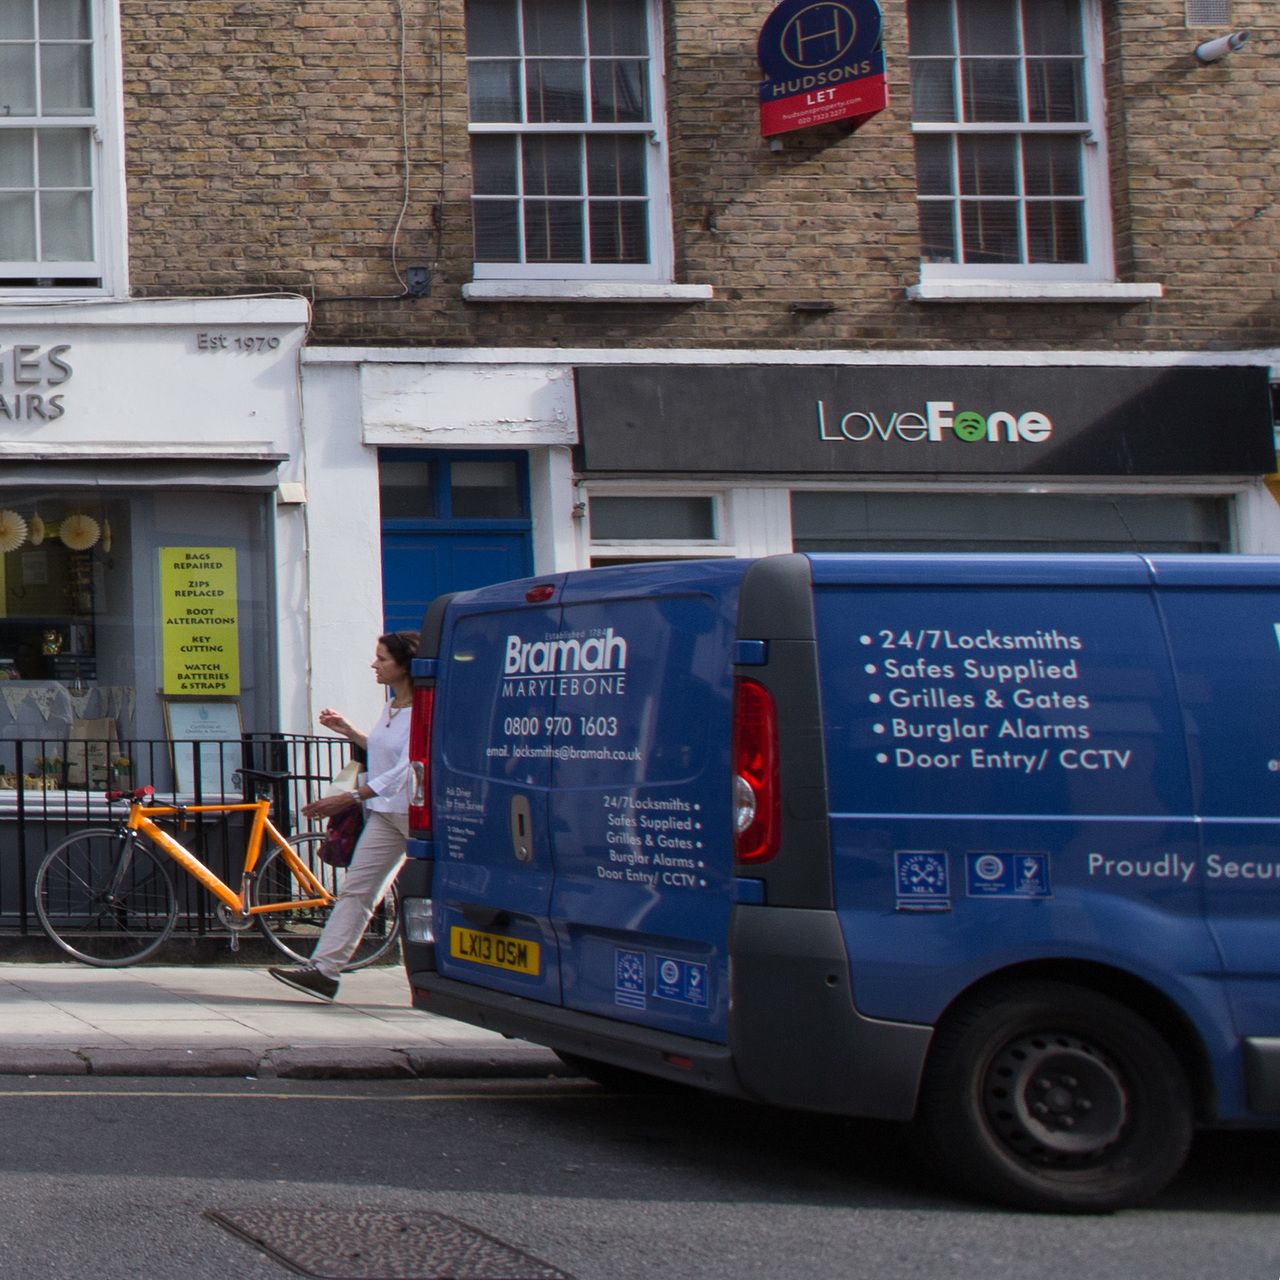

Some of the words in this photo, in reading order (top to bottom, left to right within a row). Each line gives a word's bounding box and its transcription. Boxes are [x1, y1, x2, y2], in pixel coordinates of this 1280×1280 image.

[772, 60, 871, 96] HUDSONS
[806, 88, 837, 106] LET
[196, 333, 228, 350] Est
[233, 336, 281, 352] 1970
[817, 399, 1053, 443] LoveFone
[173, 562, 223, 570] REPAIRED
[185, 553, 210, 561] BAGS
[188, 580, 210, 588] ZIPS
[175, 590, 224, 598] REPLACED
[166, 617, 235, 625] ALTERATIONS
[186, 608, 215, 616] BOOT
[545, 631, 585, 641] Established
[504, 627, 627, 674] Bramah
[184, 663, 220, 671] WATCH
[884, 658, 955, 679] Safes
[963, 658, 1078, 683] Supplied
[181, 682, 188, 690] &
[189, 682, 226, 690] STRAPS
[502, 677, 626, 697] MARYLEBONE
[889, 688, 976, 708] Grilles
[985, 689, 1004, 708] &
[1013, 689, 1090, 709] Gates
[504, 717, 539, 735] 0800
[545, 717, 572, 736] 970
[580, 716, 619, 736] 1603
[892, 718, 988, 742] Burglar
[998, 718, 1090, 739] Alarms
[513, 745, 642, 761] locksmiths@bramah.co.uk
[895, 748, 961, 768] Door
[970, 748, 1048, 773] Entry/
[1059, 749, 1132, 769] CCTV
[608, 813, 637, 827] Safes
[640, 815, 692, 831] Supplied
[606, 831, 641, 846] Grilles
[645, 834, 654, 847] &
[657, 835, 693, 849] Gates
[609, 849, 650, 866] Burglar
[653, 853, 695, 869] Alarms
[1088, 853, 1195, 883] Proudly
[597, 866, 623, 879] Door
[662, 872, 696, 887] CCTV
[460, 931, 491, 960] LX13
